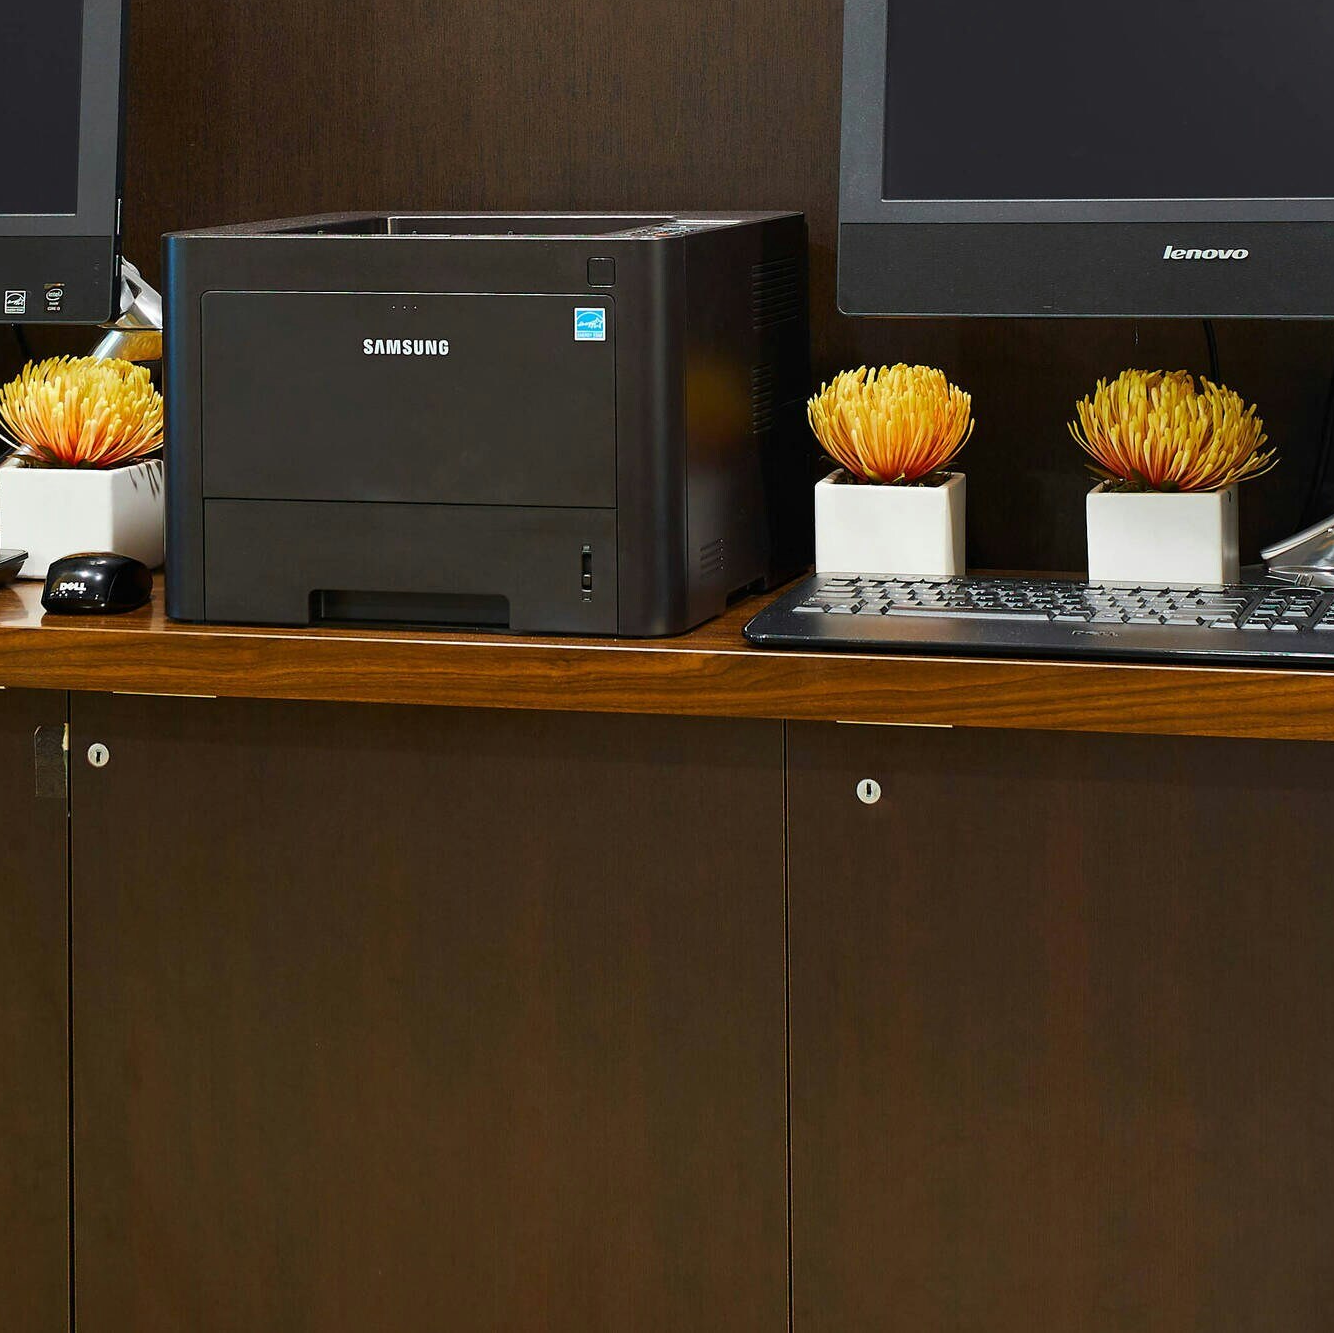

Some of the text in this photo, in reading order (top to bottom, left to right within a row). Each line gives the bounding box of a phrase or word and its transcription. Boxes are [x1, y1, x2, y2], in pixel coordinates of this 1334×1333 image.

[1163, 245, 1249, 260] lenovo
[362, 338, 450, 356] SAMSUNG
[59, 582, 87, 591] DELL
